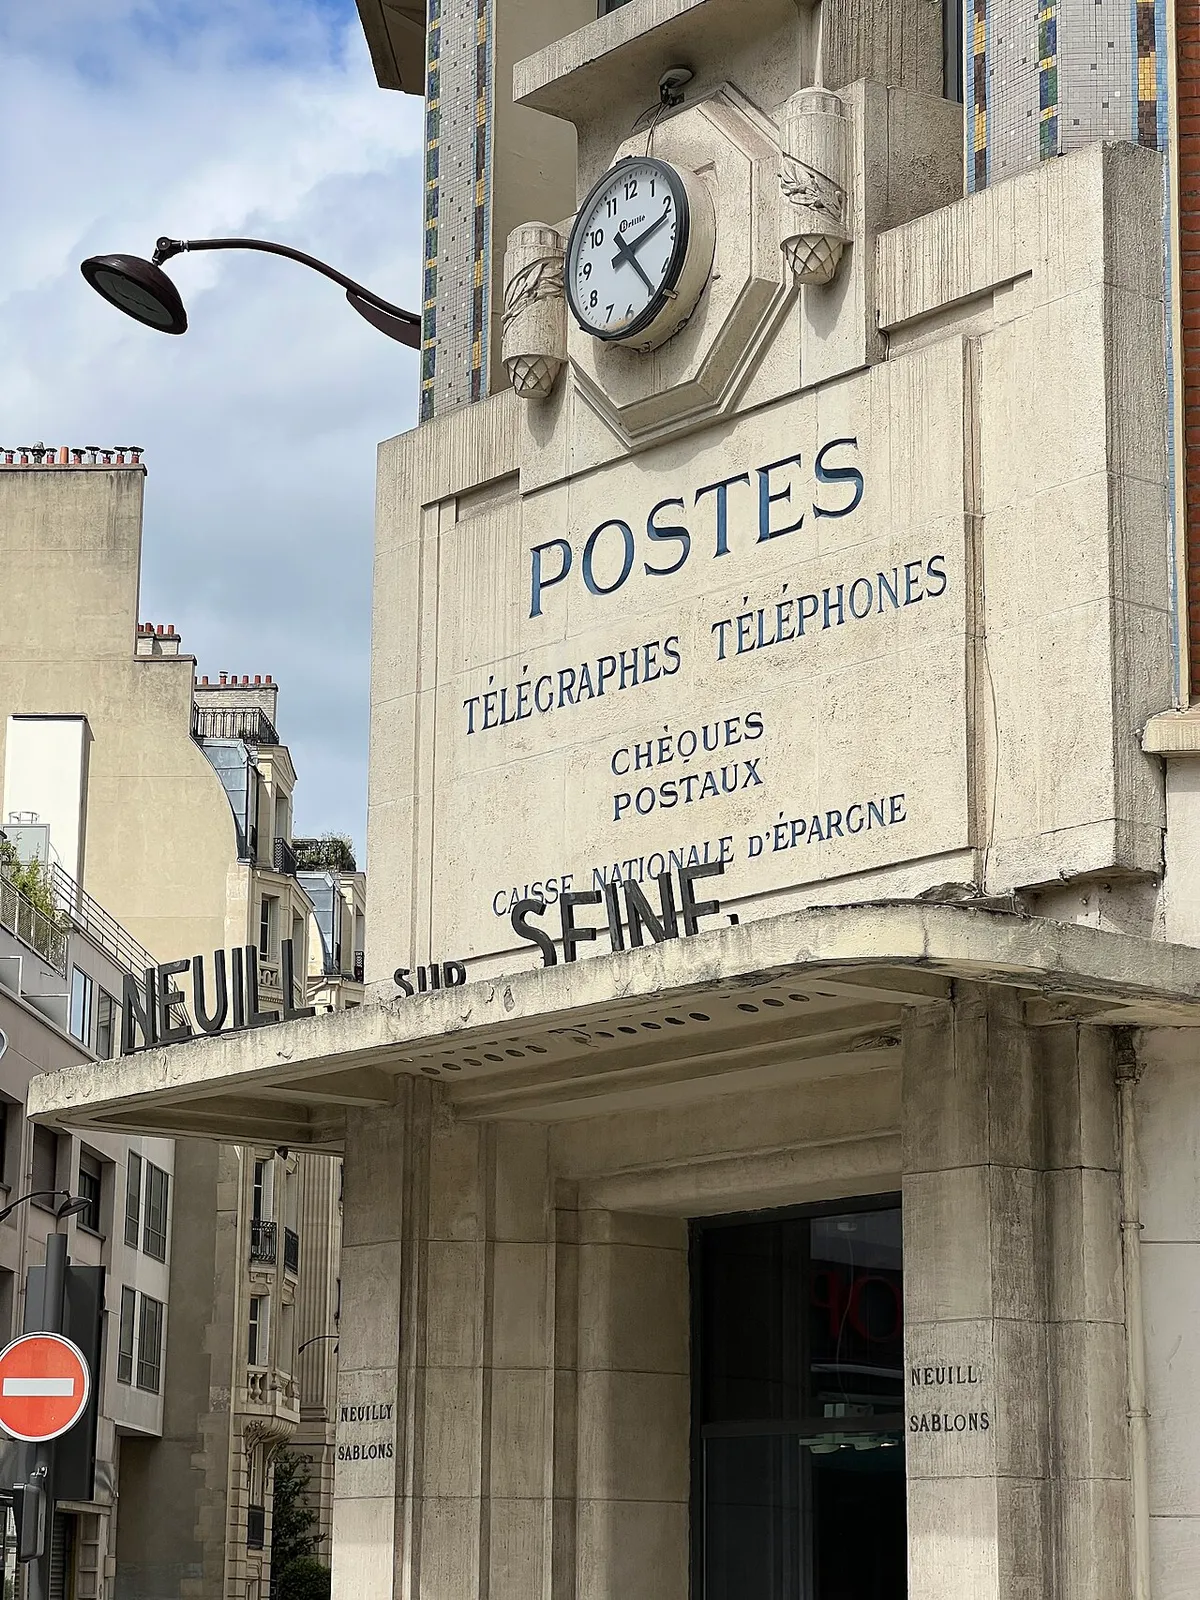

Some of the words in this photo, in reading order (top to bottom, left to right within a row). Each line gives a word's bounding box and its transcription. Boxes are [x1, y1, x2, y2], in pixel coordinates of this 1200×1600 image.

[624, 180, 638, 201] 12
[649, 180, 655, 198] 1
[606, 197, 617, 218] 11
[662, 196, 672, 214] 2
[590, 228, 604, 250] 10
[583, 262, 592, 281] 9
[589, 290, 598, 308] 8
[605, 304, 615, 323] 7
[625, 304, 635, 321] 6
[528, 436, 864, 619] POSTES
[463, 636, 682, 736] TÉLÉGRAPHES
[711, 554, 948, 662] TÉLÉPHONES
[611, 711, 764, 776] CHÈQUES
[612, 757, 763, 822] POSTAUX
[591, 835, 735, 893] NATIONALE
[122, 938, 335, 1054] NEUILL
[911, 1365, 983, 1386] NEUILL
[340, 1404, 393, 1422] NEUILLY
[909, 1412, 990, 1433] SABLONS
[338, 1443, 393, 1461] SABLONS
